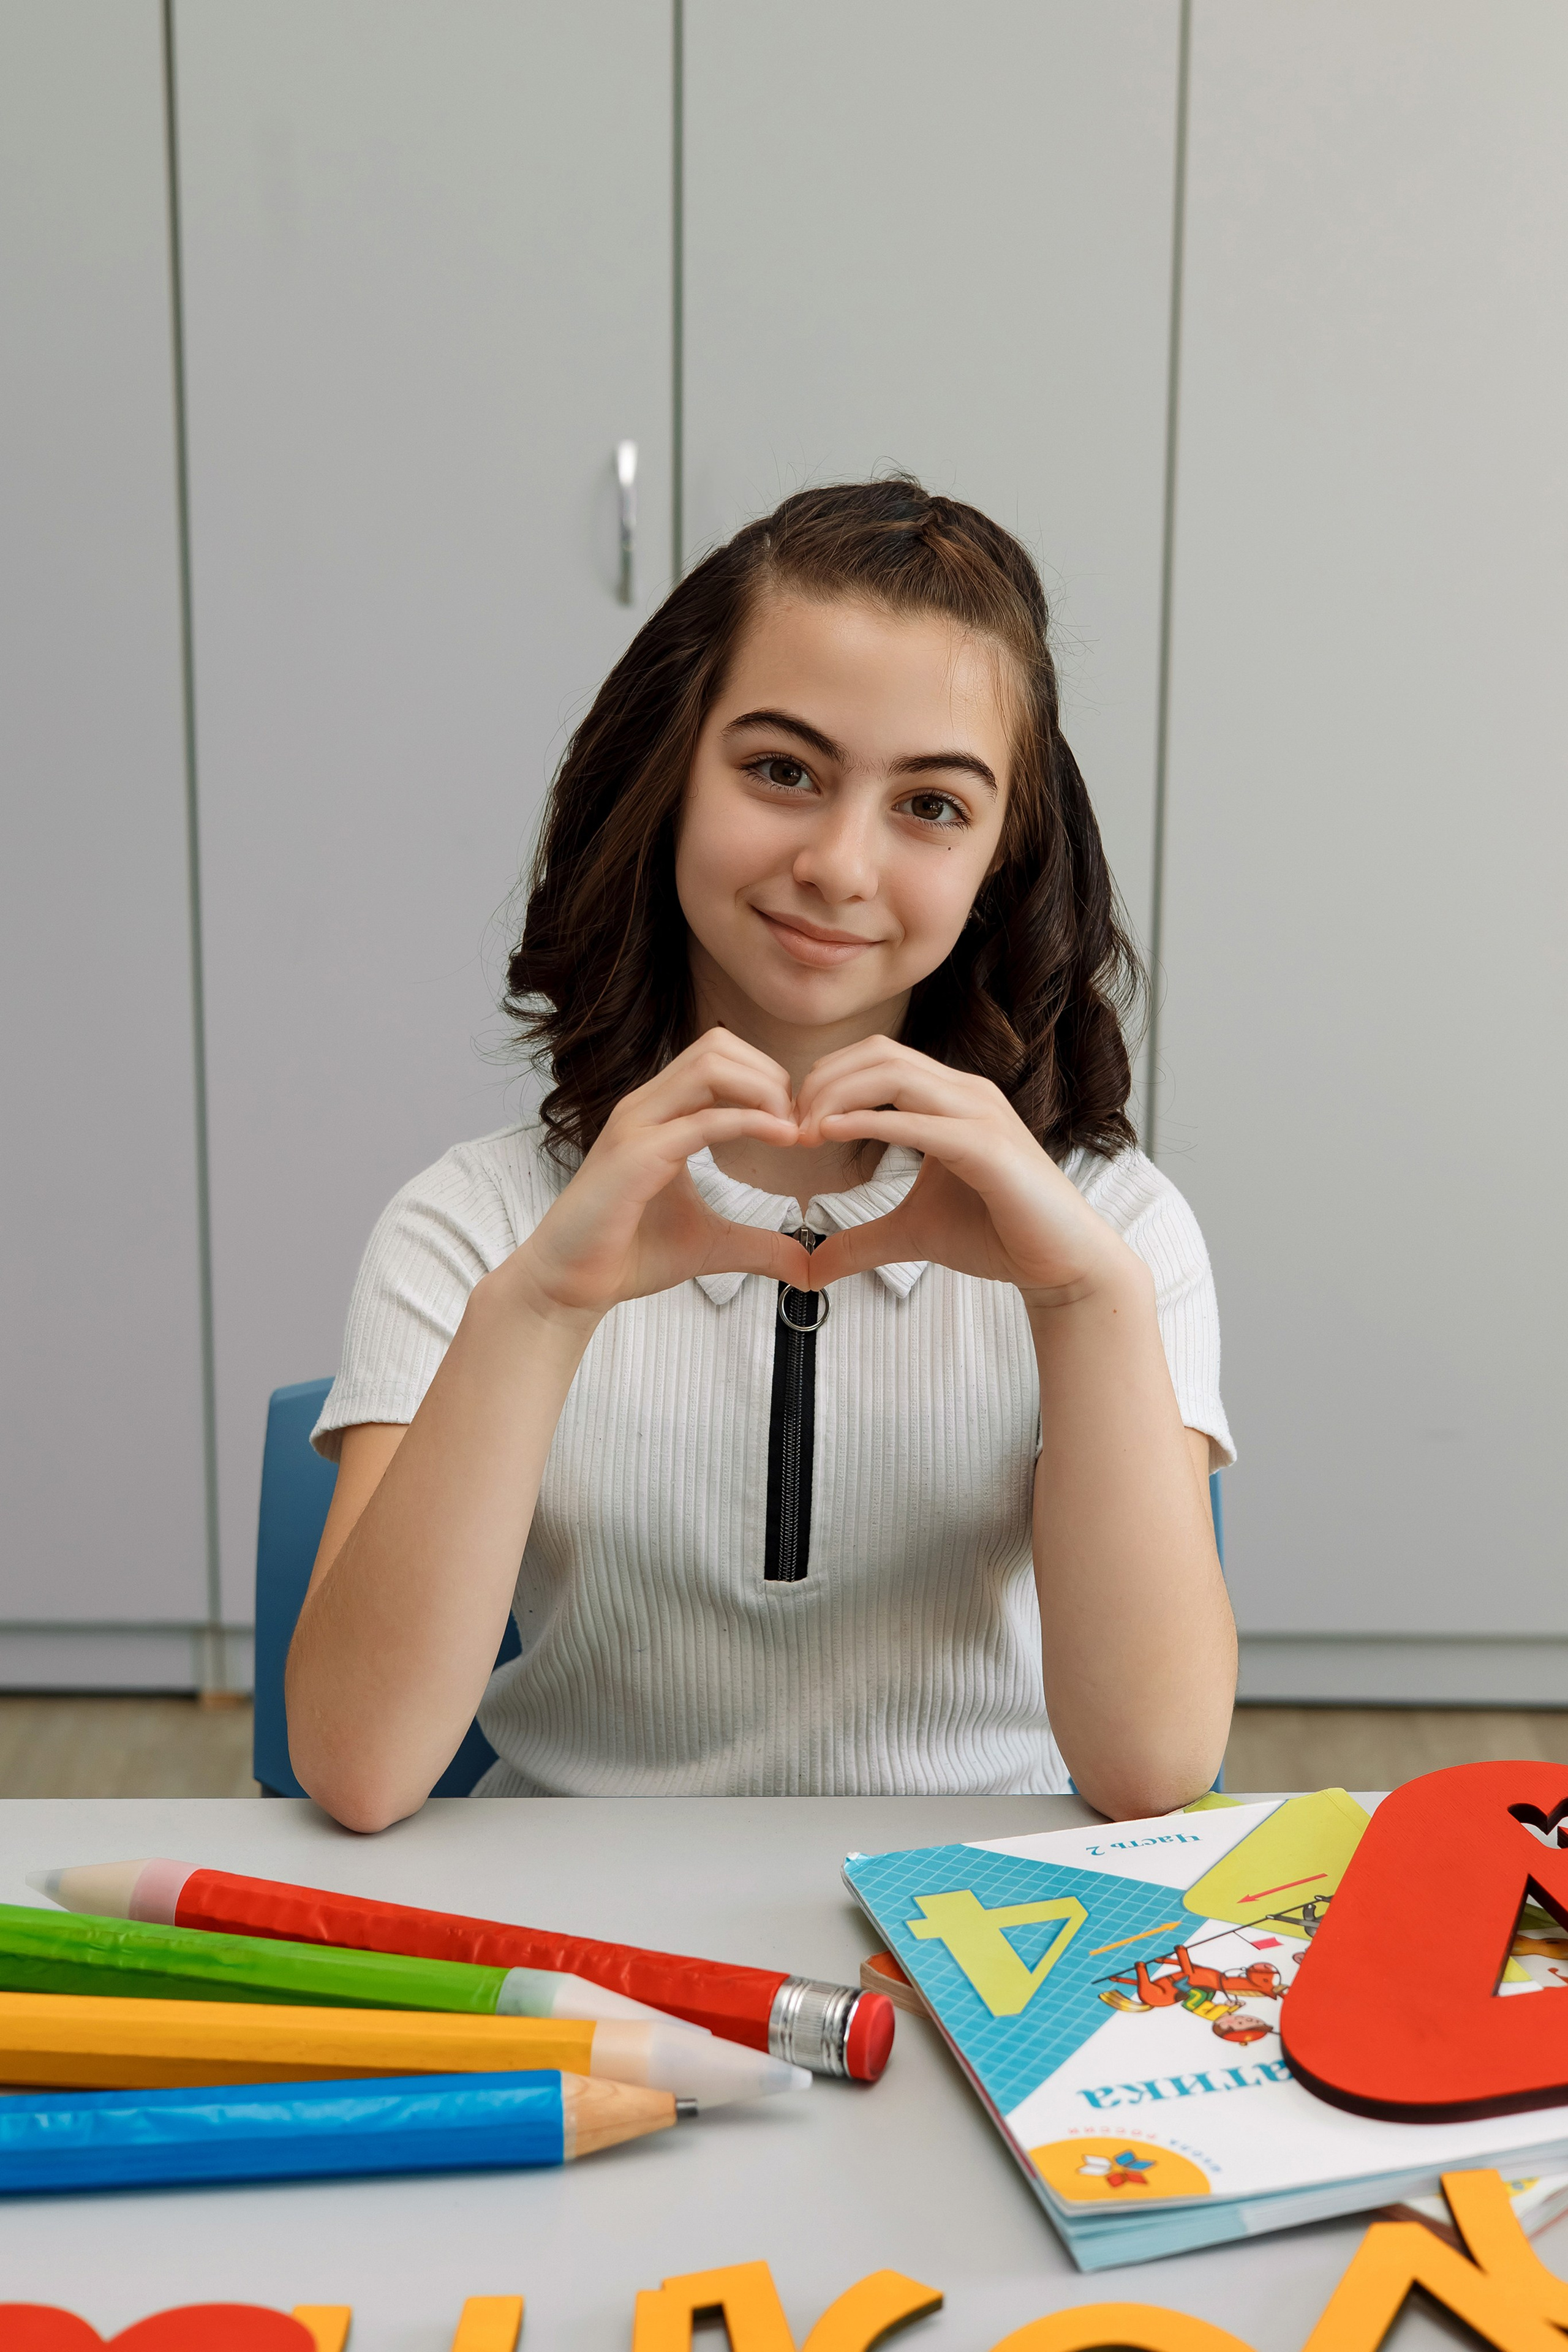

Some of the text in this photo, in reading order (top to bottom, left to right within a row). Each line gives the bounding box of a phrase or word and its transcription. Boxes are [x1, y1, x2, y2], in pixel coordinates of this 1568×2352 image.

[1085, 1833, 1204, 1856] Часть 2
[905, 1889, 1089, 2017] 4
[1076, 2059, 1294, 2109] атика
